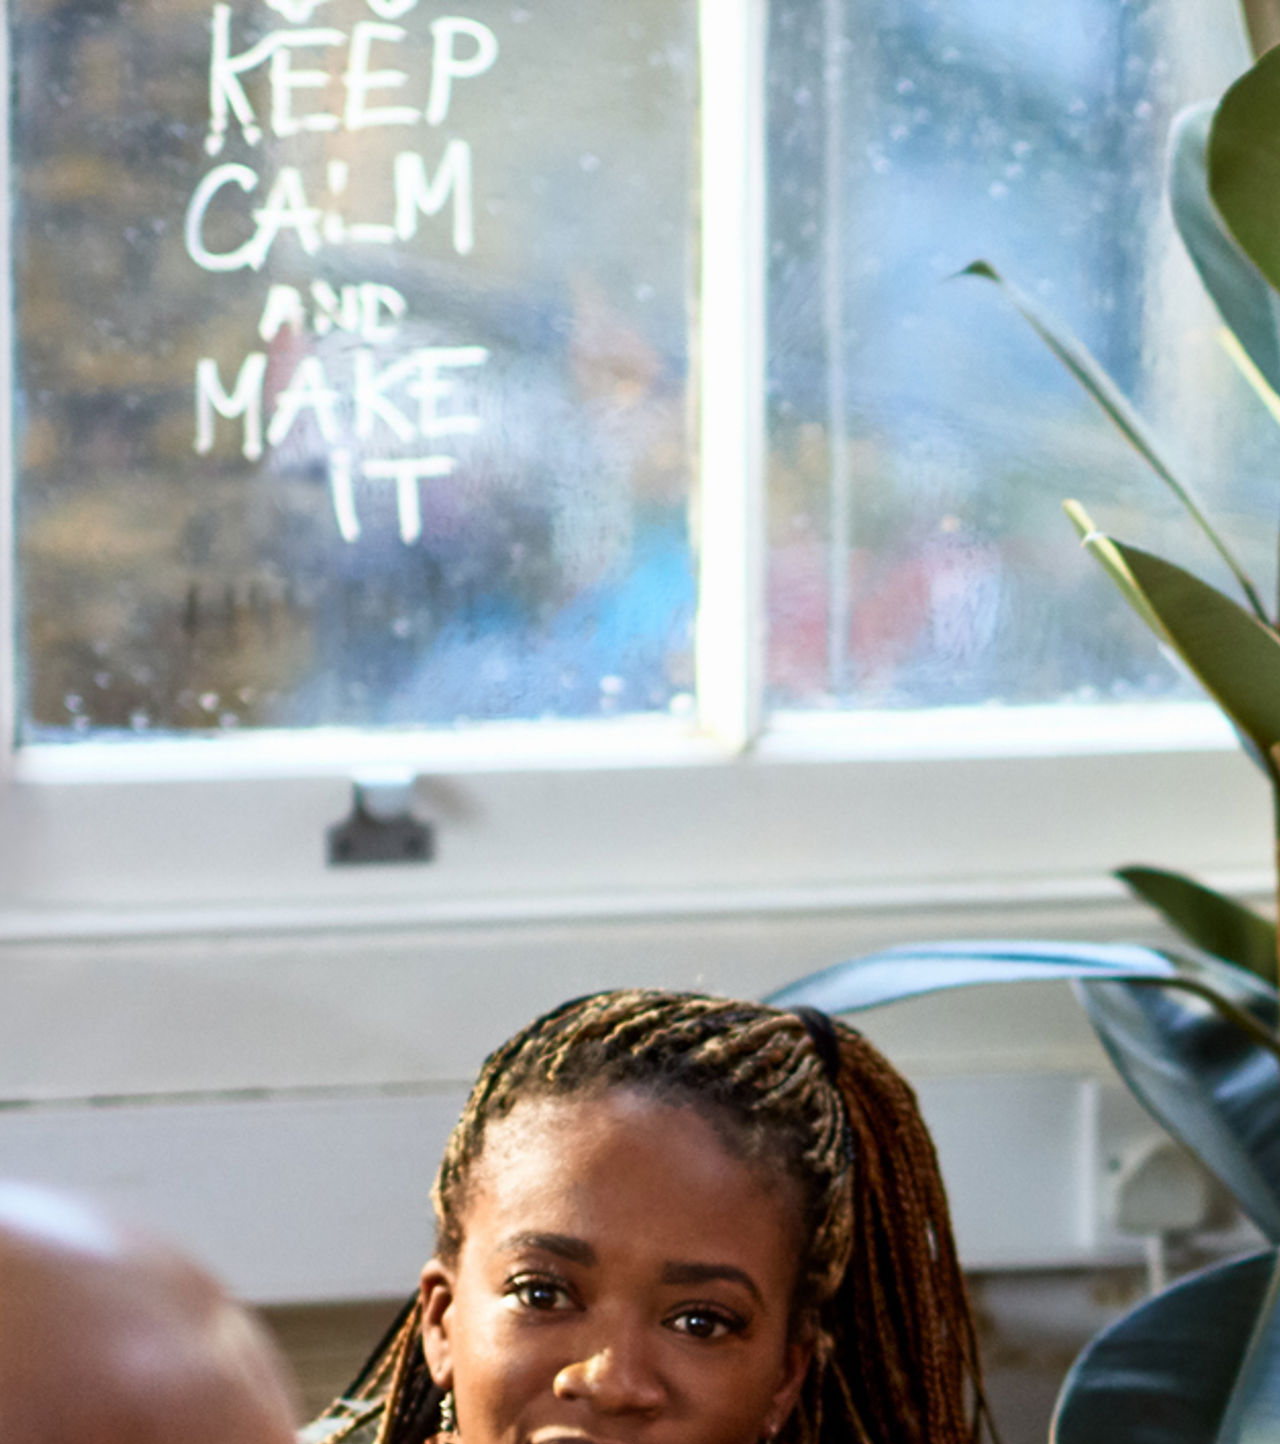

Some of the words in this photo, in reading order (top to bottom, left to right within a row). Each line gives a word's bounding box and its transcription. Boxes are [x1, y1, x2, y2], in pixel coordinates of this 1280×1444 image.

[205, 4, 498, 155] KEEP
[185, 139, 473, 272] CALM
[259, 280, 407, 343] AND
[194, 346, 489, 462] MAKE
[329, 447, 458, 545] IT
